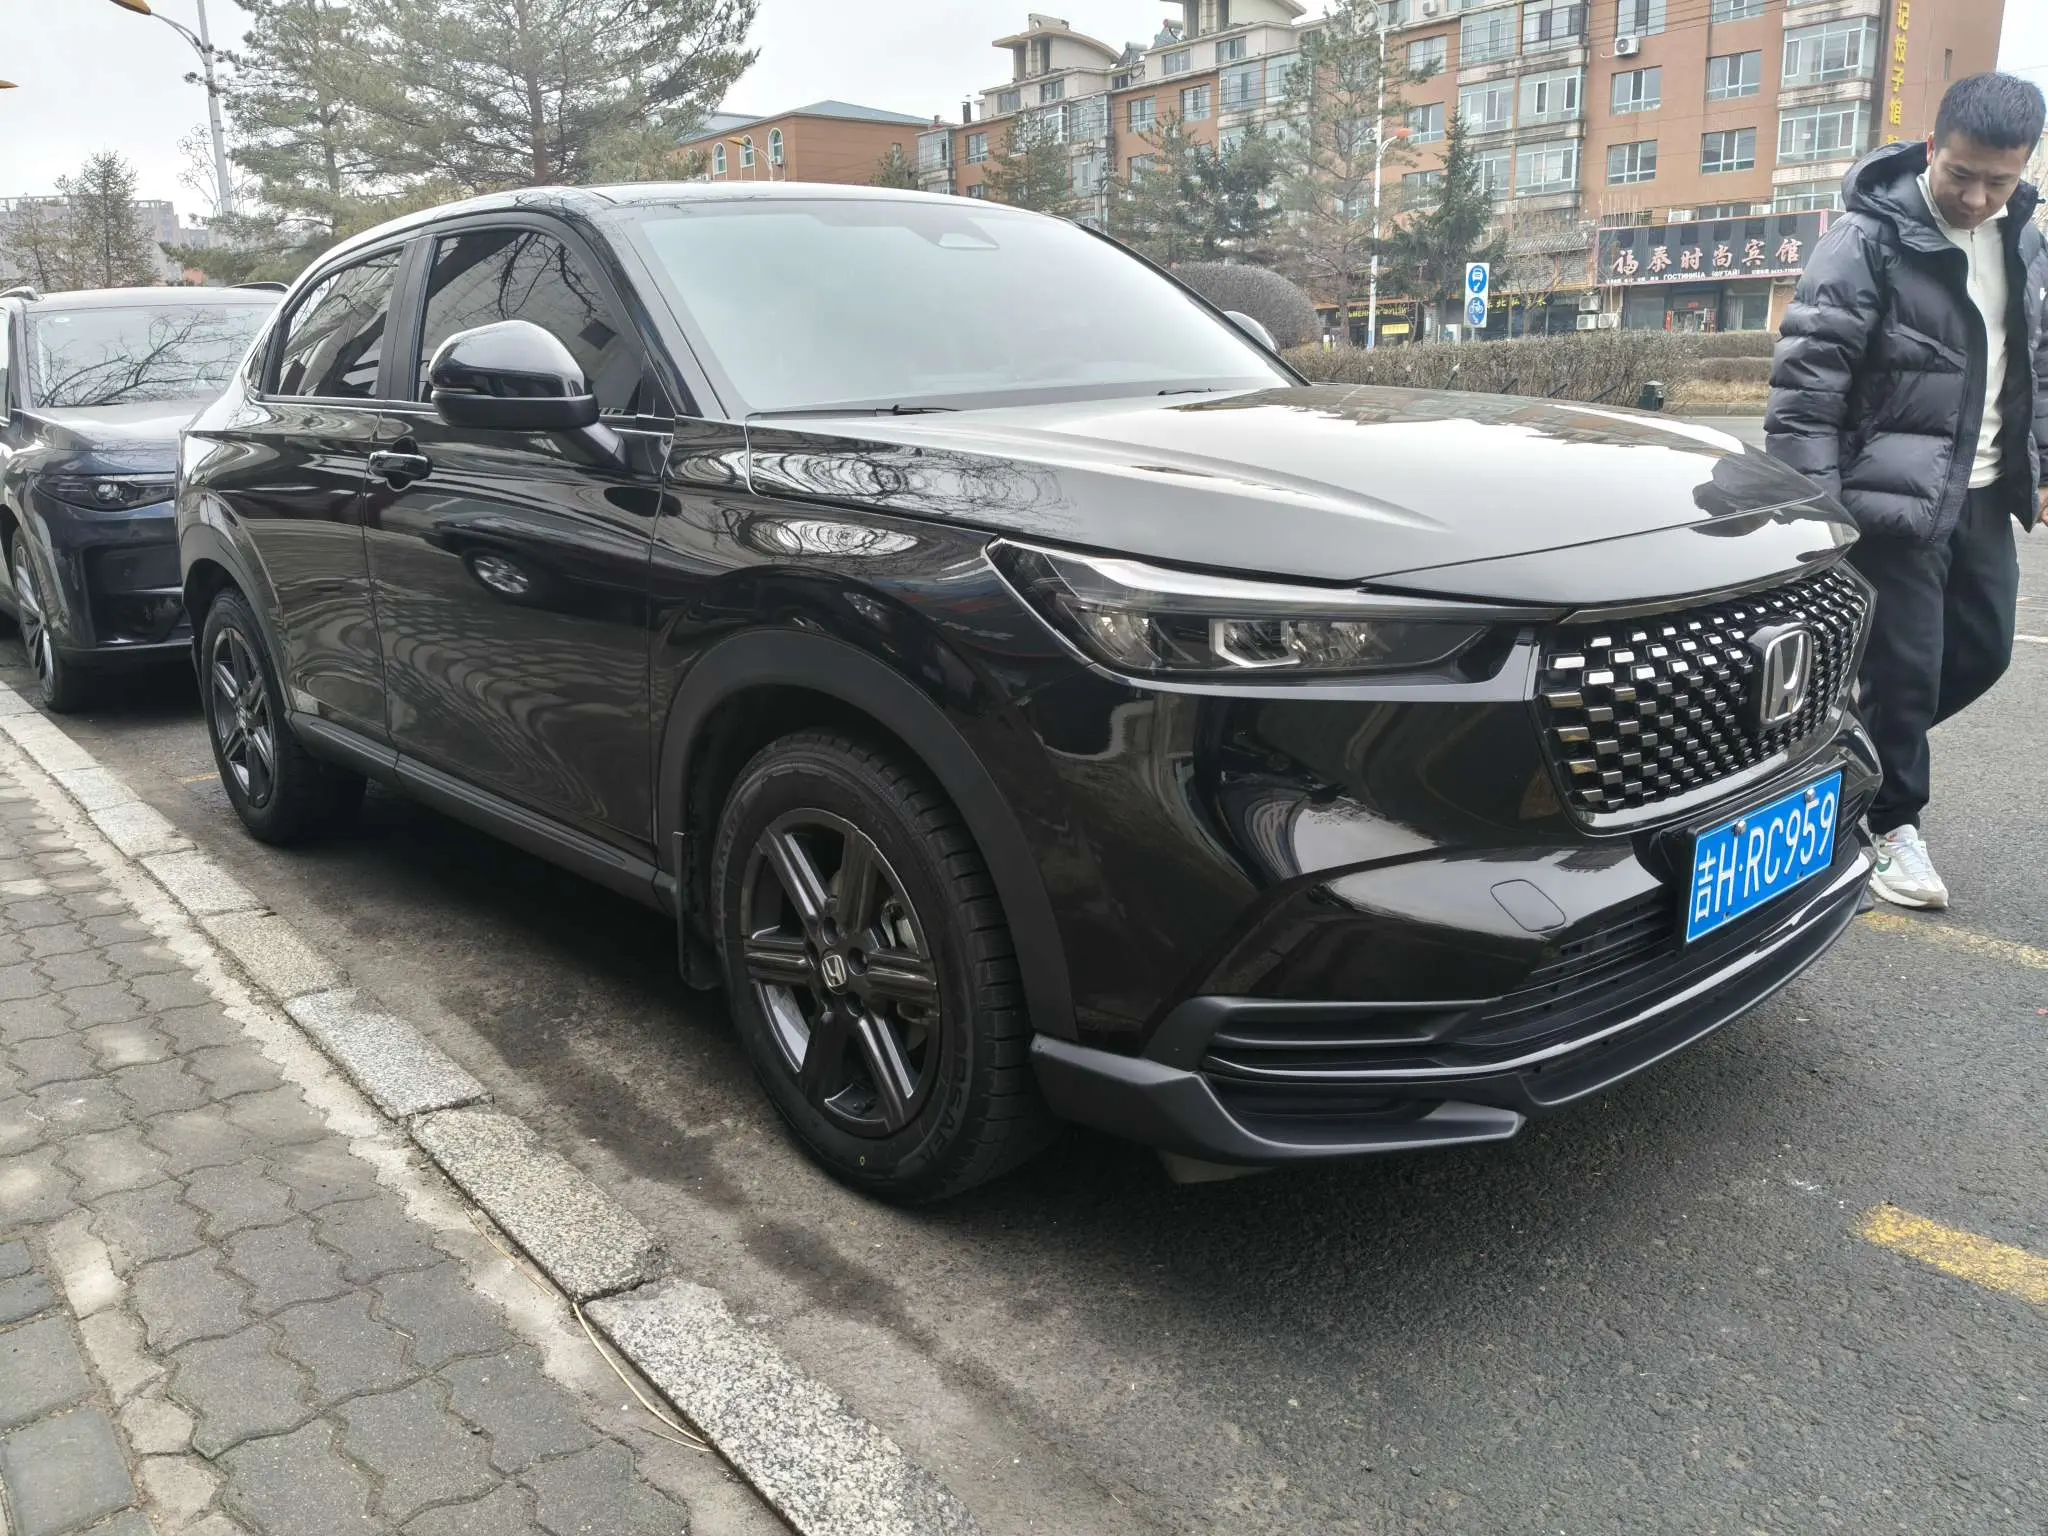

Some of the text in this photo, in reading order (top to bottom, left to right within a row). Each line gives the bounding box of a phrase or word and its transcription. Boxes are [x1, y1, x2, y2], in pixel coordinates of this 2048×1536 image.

[1613, 238, 1803, 275] 福泰时尚宾馆
